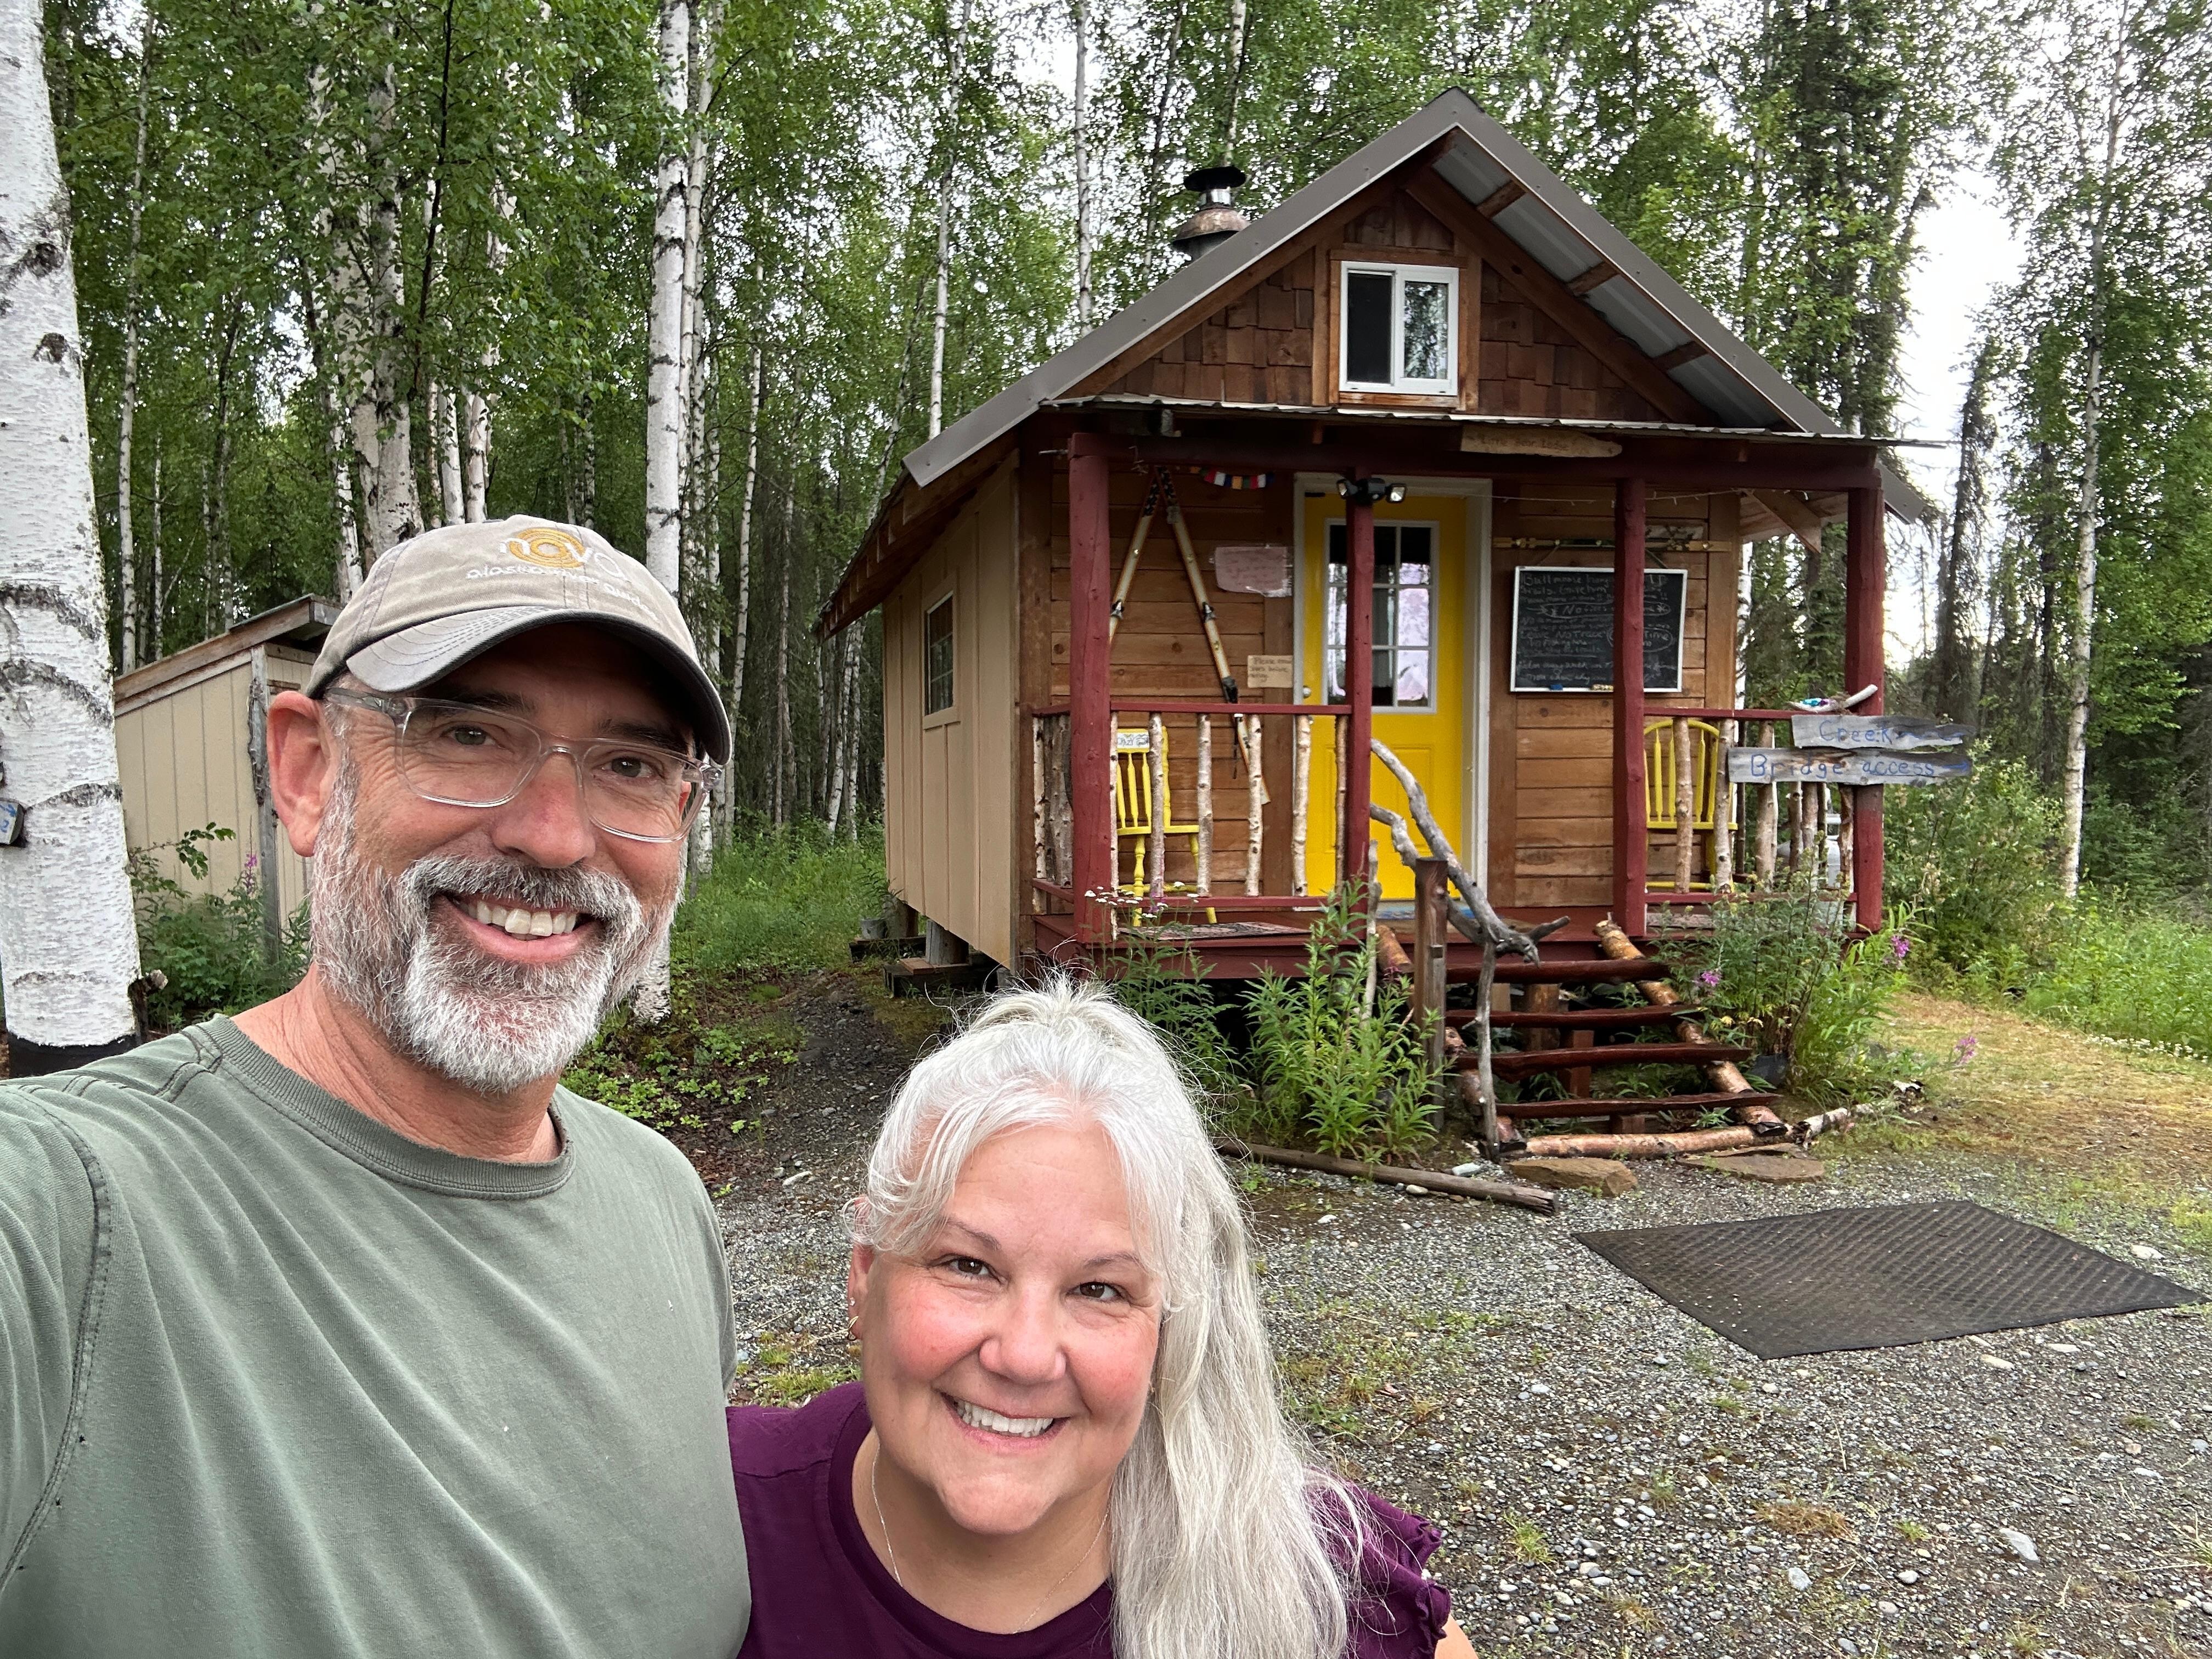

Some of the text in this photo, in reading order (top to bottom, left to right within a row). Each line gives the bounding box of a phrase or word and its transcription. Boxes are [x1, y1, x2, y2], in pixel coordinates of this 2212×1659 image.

[1819, 720, 1893, 745] Creek
[1751, 752, 1935, 779] Bridge access
